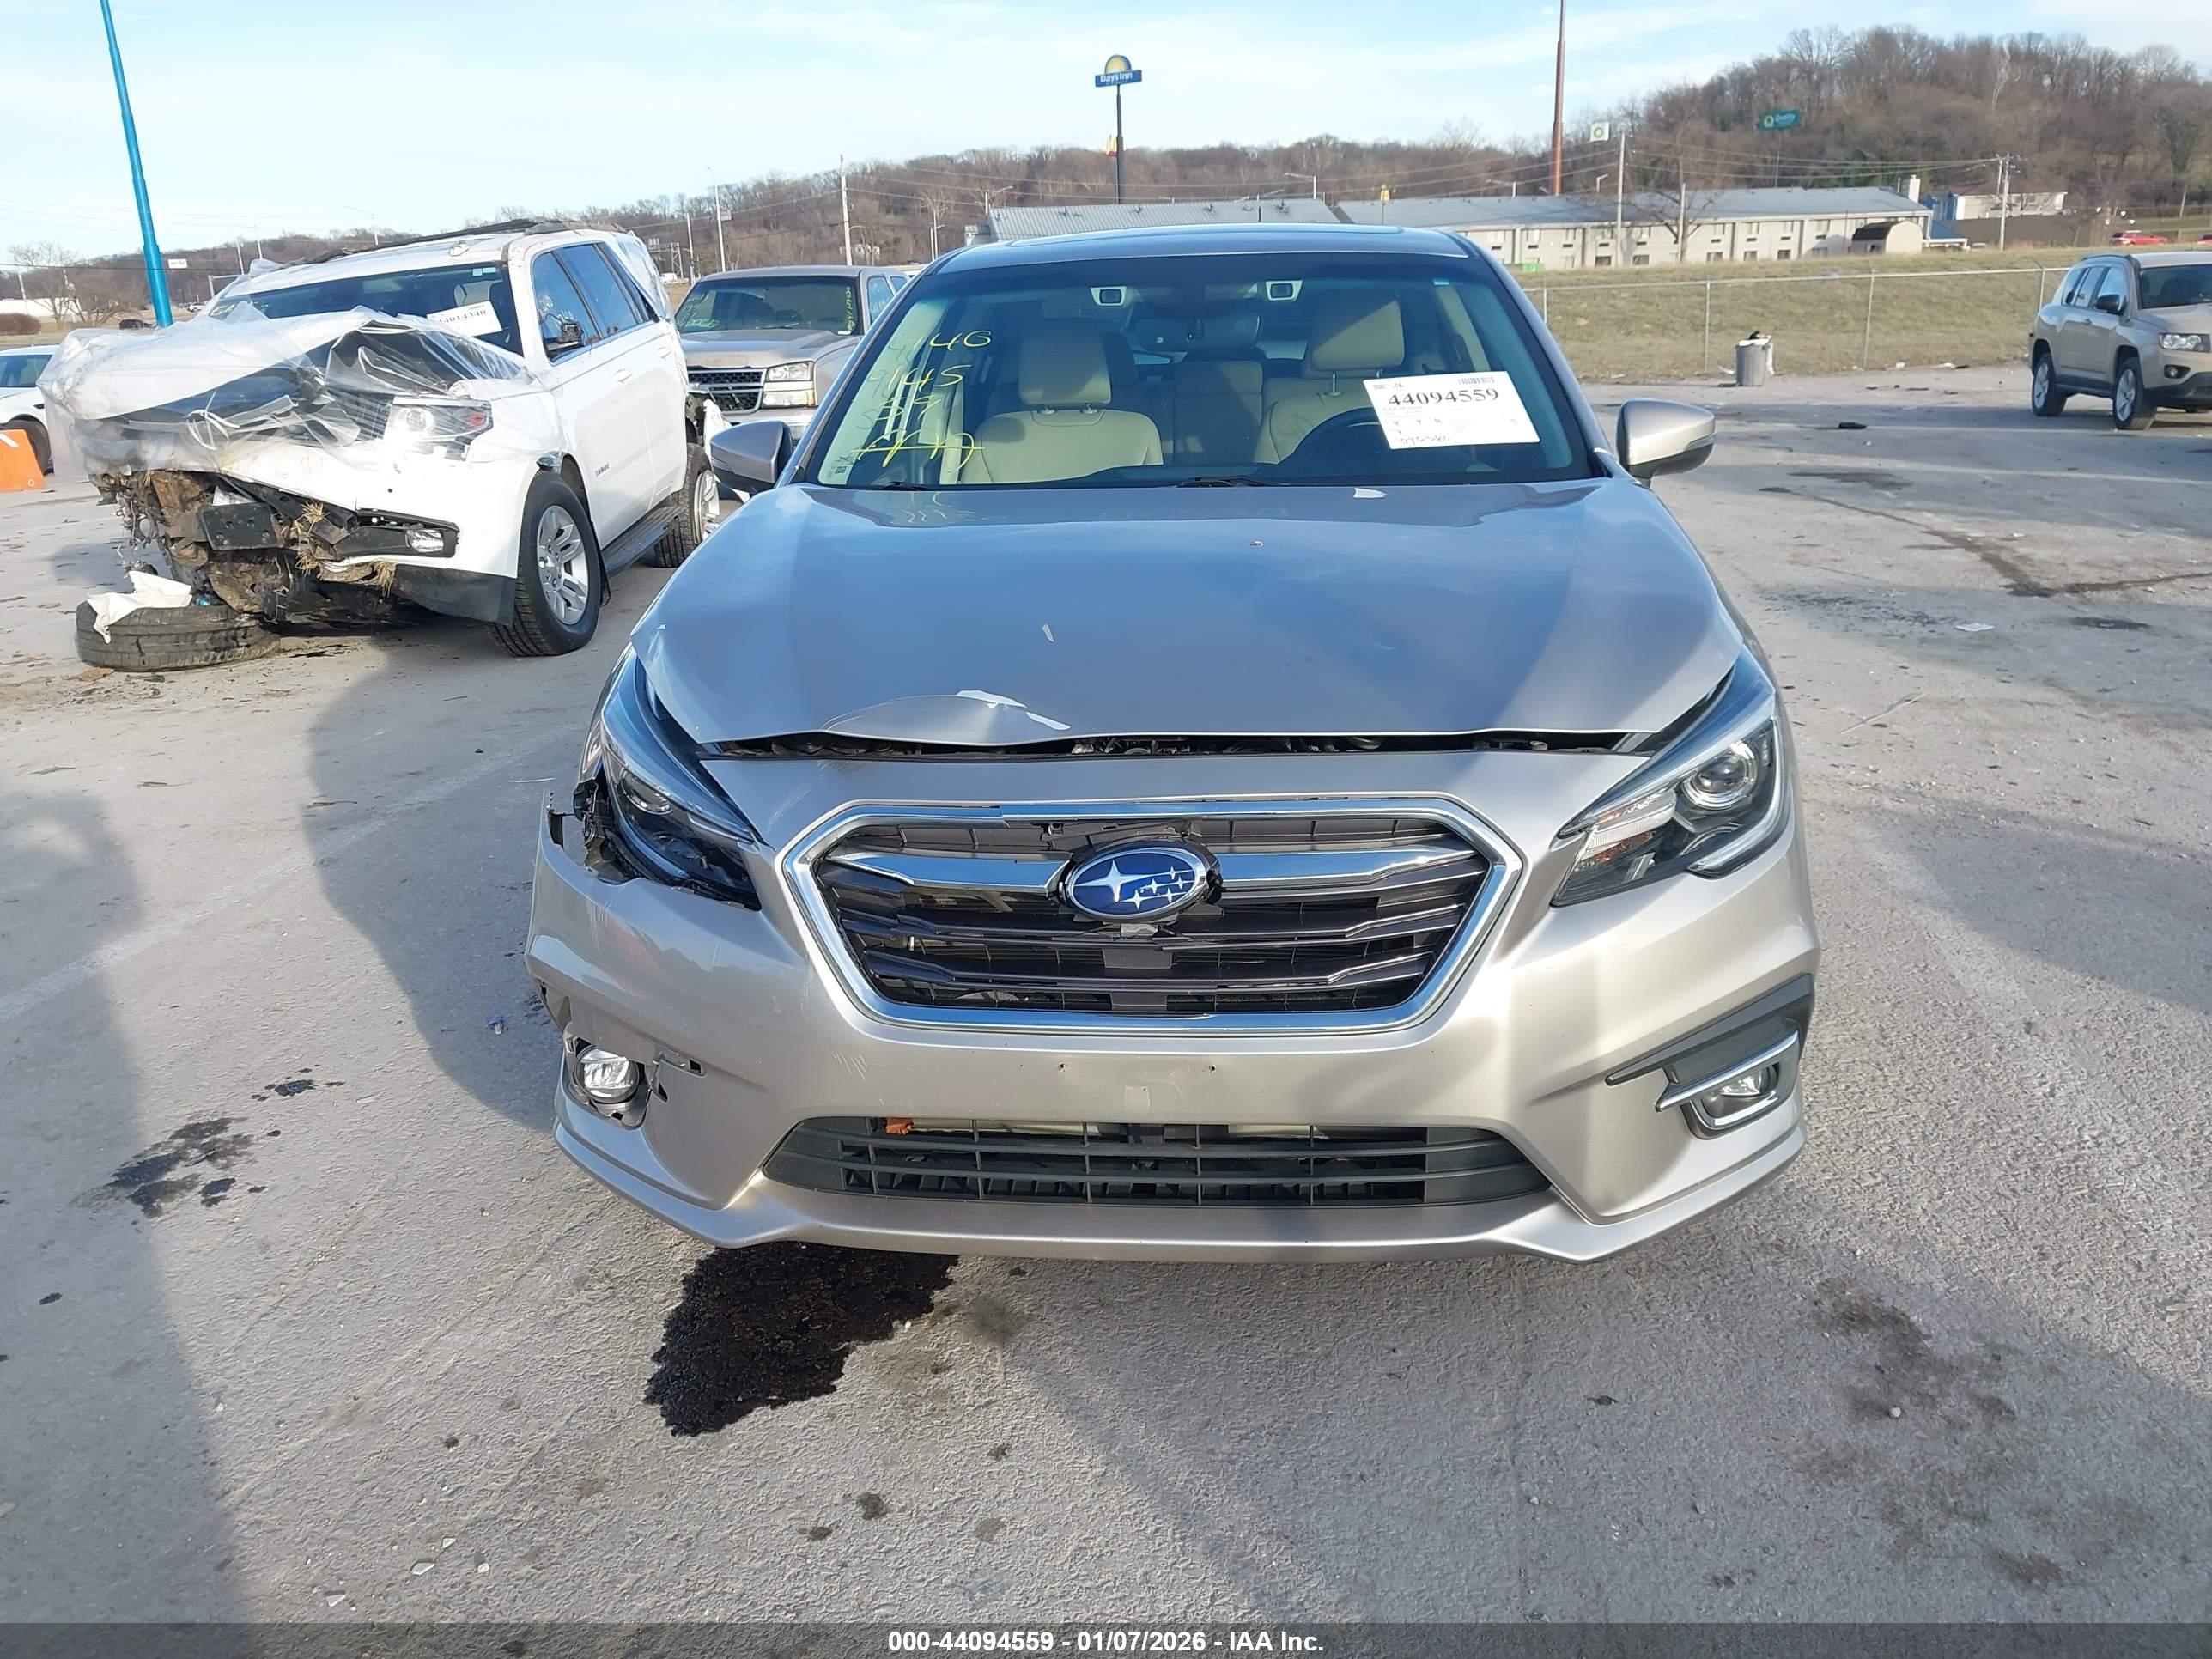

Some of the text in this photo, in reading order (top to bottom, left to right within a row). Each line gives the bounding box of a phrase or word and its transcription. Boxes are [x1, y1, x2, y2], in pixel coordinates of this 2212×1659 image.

[1100, 75, 1119, 83] Days
[1120, 70, 1133, 81] Inn
[1388, 388, 1499, 406] 44094559
